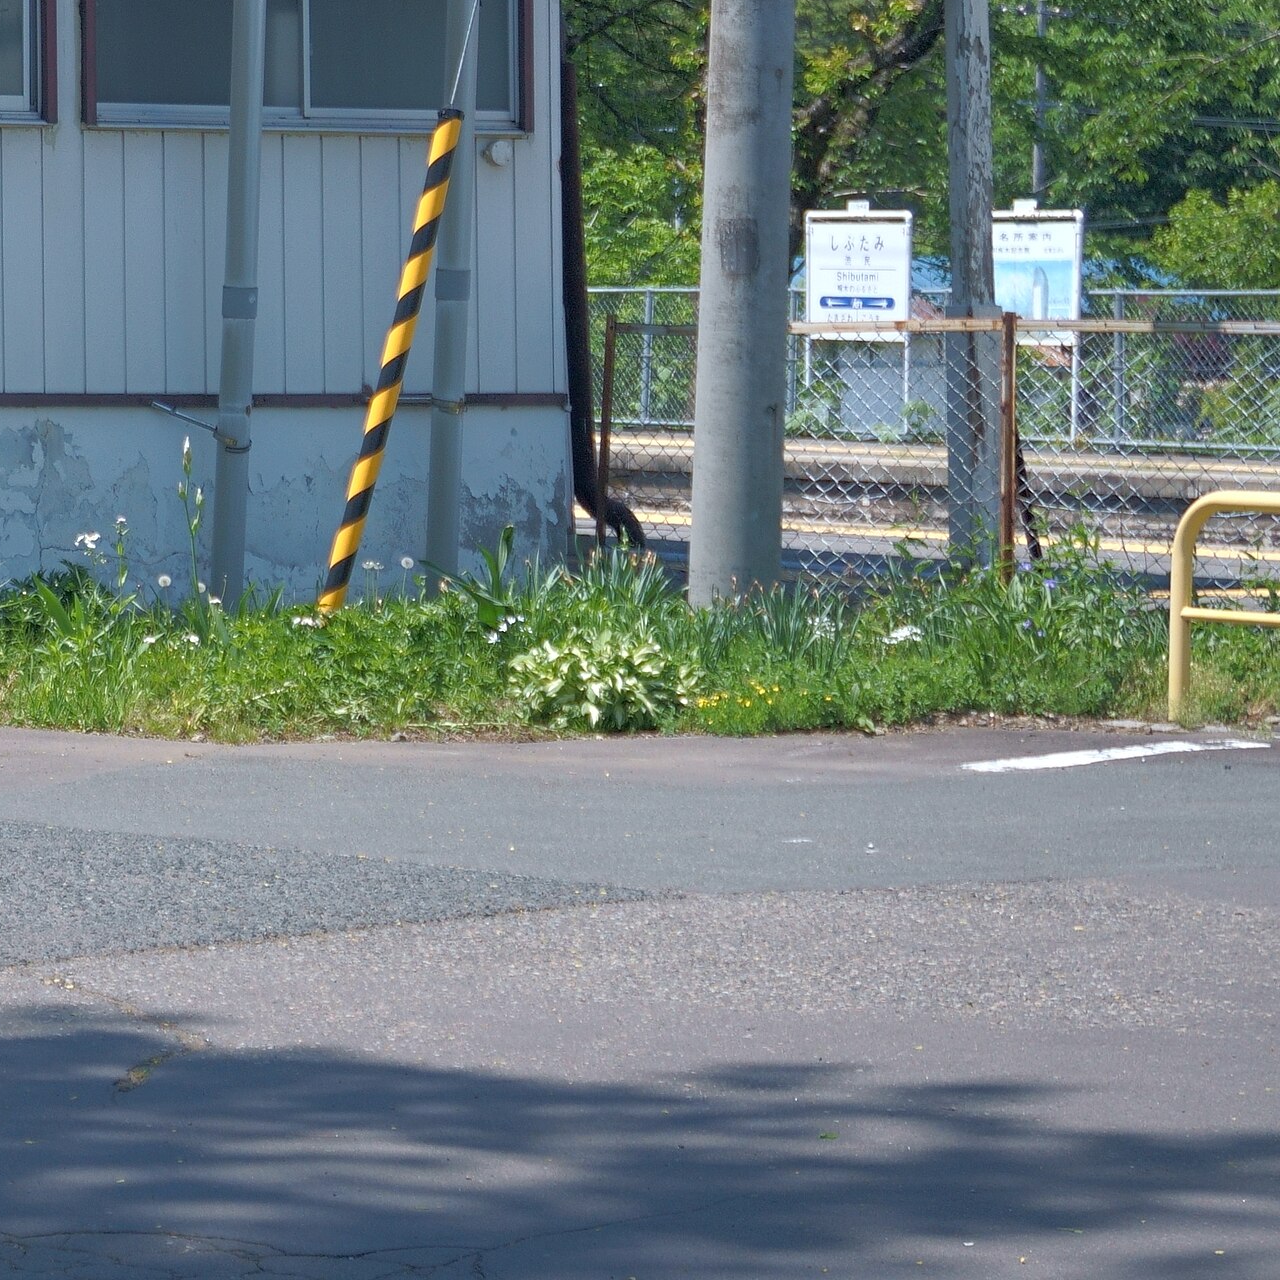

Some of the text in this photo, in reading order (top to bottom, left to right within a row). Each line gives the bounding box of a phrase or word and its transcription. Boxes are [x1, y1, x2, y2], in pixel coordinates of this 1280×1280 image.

[831, 235, 884, 252] しぶたみ
[836, 271, 879, 282] Shibutami
